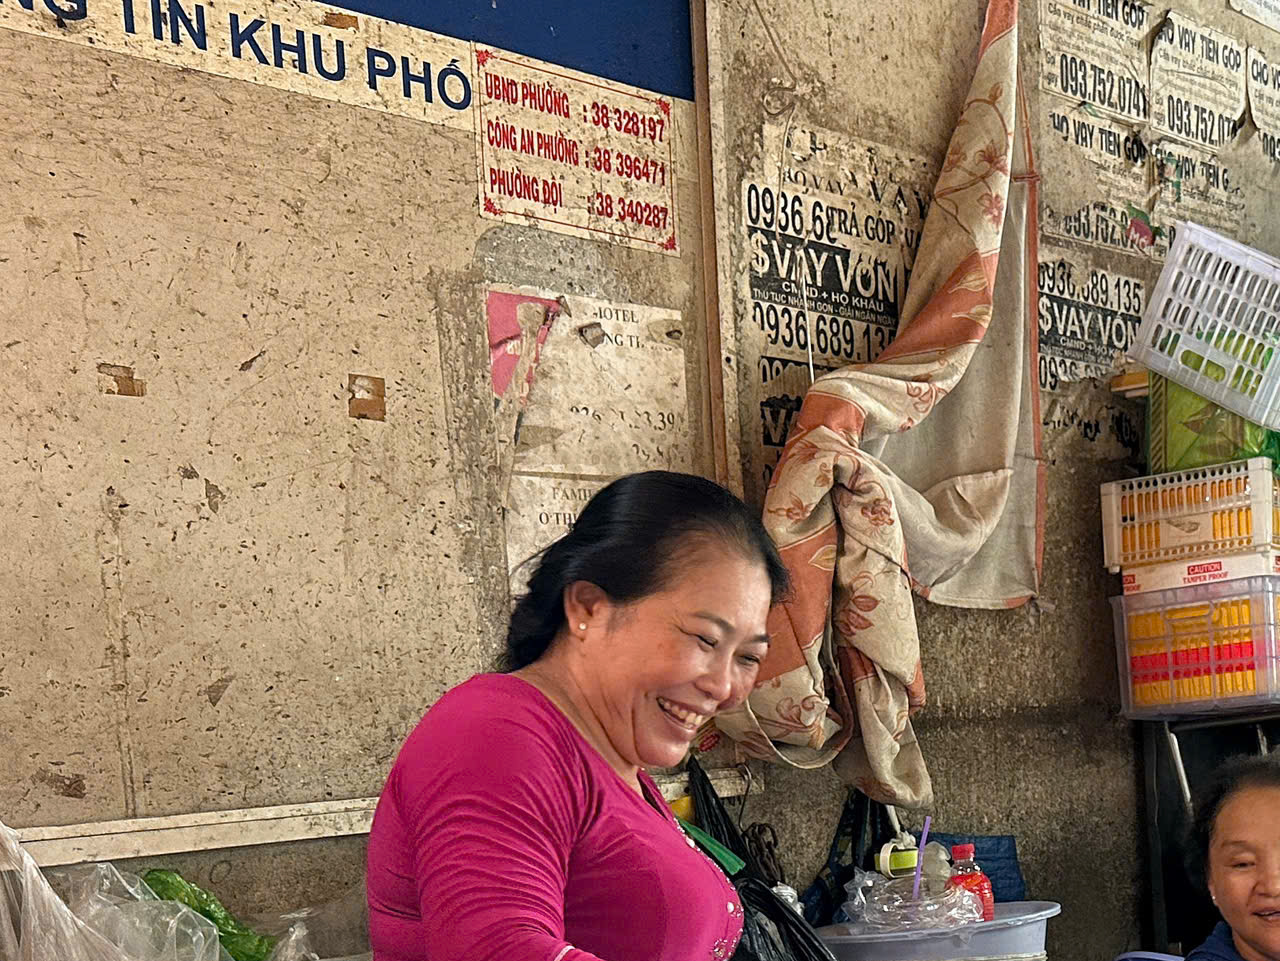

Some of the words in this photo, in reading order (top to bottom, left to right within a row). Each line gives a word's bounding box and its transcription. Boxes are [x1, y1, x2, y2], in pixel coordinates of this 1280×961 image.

[1178, 24, 1196, 54] VAY
[228, 12, 345, 81] KHU
[366, 46, 471, 111] PHỐ
[1251, 58, 1269, 86] CHO
[485, 71, 518, 105] UBND
[591, 101, 610, 129] 38
[614, 107, 665, 142] 328197
[1072, 118, 1095, 149] VAY
[487, 115, 517, 152] CÔNG
[520, 128, 534, 156] AN
[593, 145, 612, 174] 38
[616, 151, 666, 187] 396471
[596, 191, 614, 218] 38
[618, 196, 669, 230] 340287
[1189, 562, 1221, 575] CAUTION
[1209, 571, 1229, 581] PROOF
